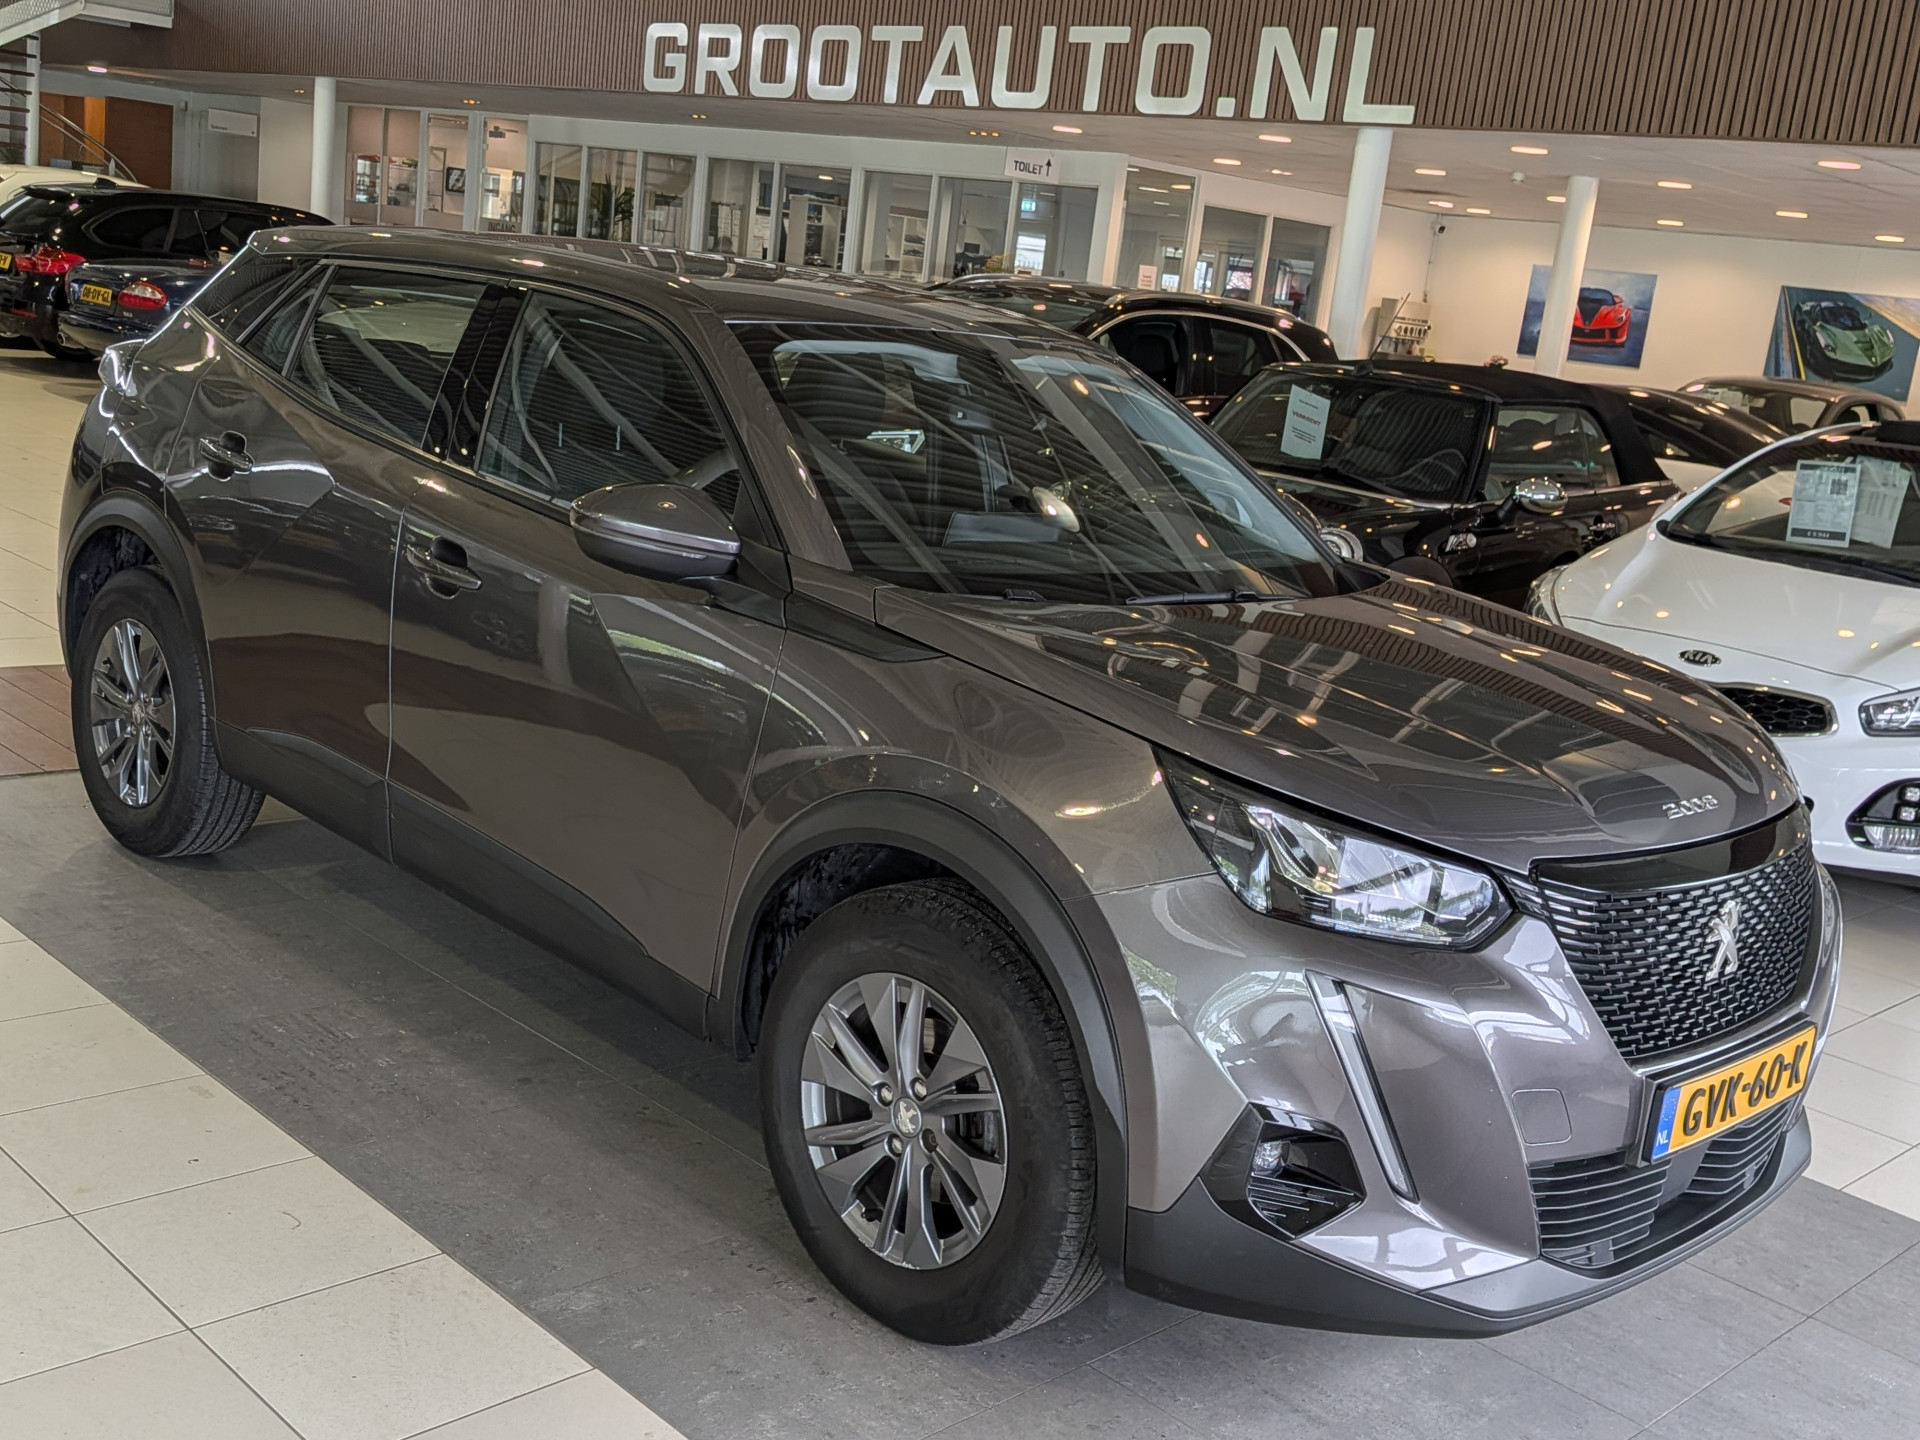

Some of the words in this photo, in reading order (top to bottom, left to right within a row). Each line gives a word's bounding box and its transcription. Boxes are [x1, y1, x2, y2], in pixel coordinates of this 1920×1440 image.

[643, 22, 1415, 125] GROOTAUTO.NL
[1013, 159, 1044, 175] TOILET
[1683, 650, 1713, 664] KIA
[1662, 794, 1719, 820] 2008
[1682, 1040, 1809, 1137] GVK-60-K
[1655, 1130, 1669, 1147] NL
